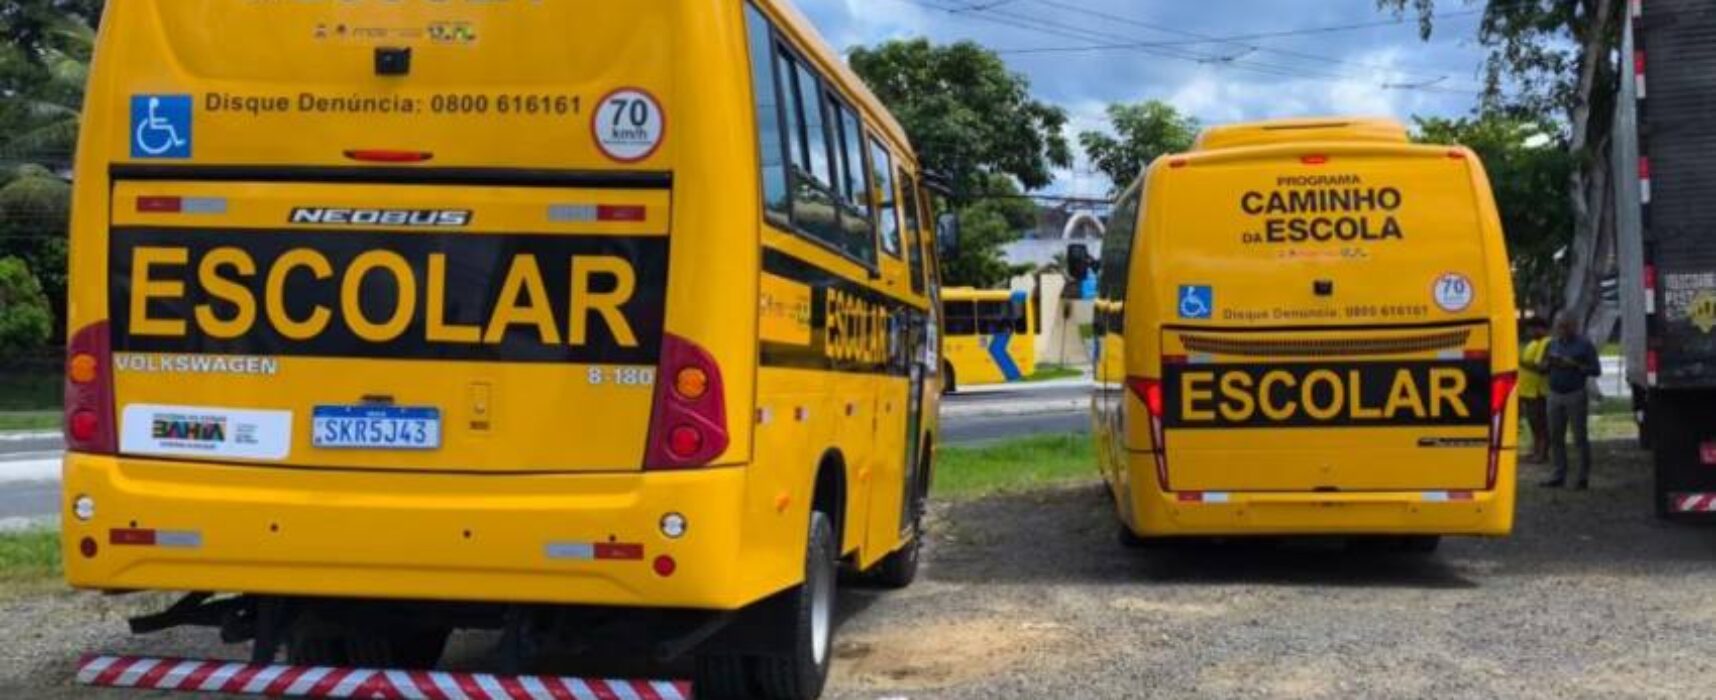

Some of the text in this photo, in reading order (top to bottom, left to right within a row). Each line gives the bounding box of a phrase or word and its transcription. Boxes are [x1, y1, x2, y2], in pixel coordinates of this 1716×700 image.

[205, 92, 581, 115] Disque Denúncia: 0800 616161
[609, 99, 648, 127] 70
[611, 128, 648, 141] km/h
[1276, 174, 1361, 186] PROGRAMA
[1241, 187, 1402, 215] CAMINHO
[293, 208, 470, 226] NEOBUS
[1242, 216, 1403, 244] DA ESCOLA
[128, 246, 639, 347] ESCOLAR
[1442, 279, 1465, 294] 70
[113, 353, 279, 374] VOLKSWAGEN
[1180, 367, 1471, 422] ESCOLAR
[324, 419, 427, 444] SKR5J43
